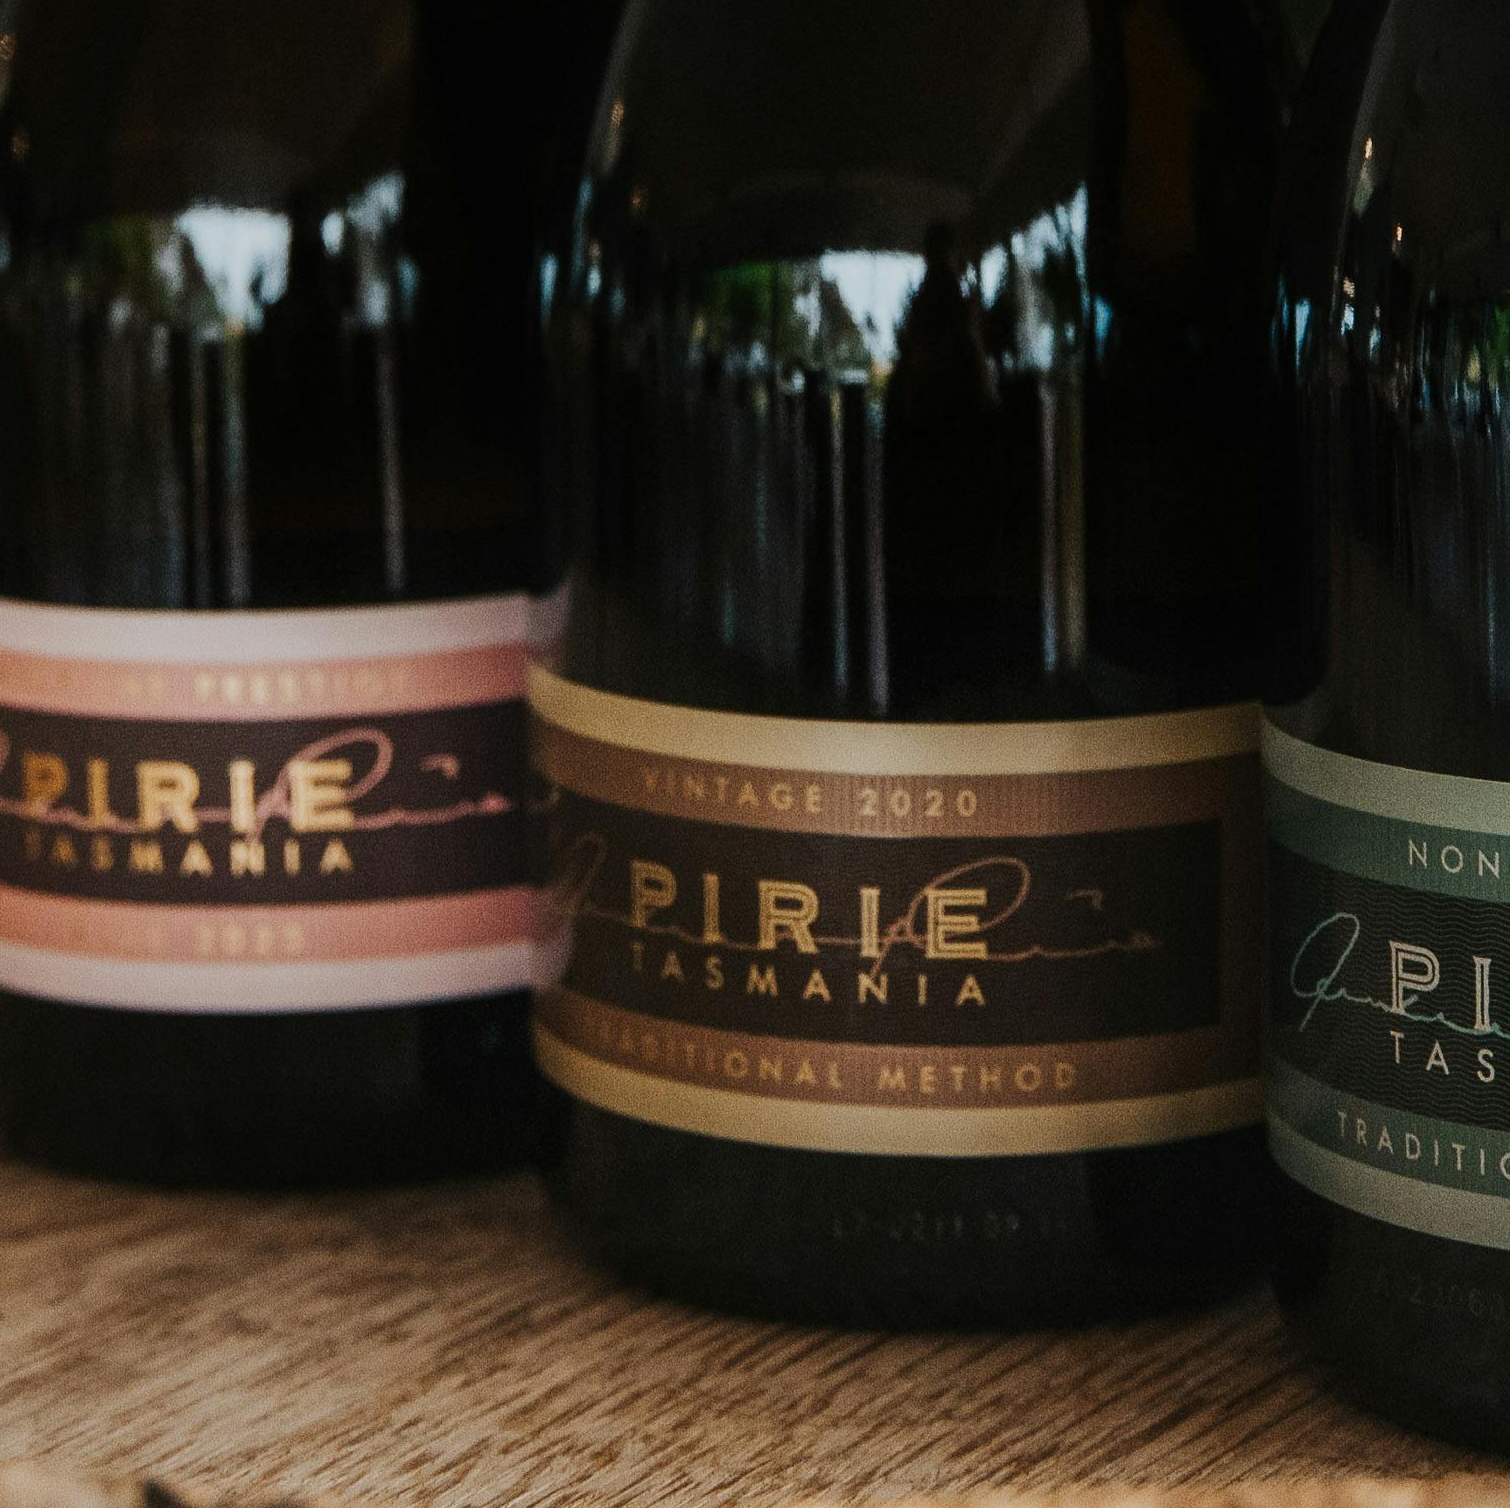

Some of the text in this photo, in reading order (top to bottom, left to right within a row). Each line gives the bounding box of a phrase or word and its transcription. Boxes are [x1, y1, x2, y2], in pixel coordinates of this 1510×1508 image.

[22, 751, 356, 833] PIRIE
[644, 765, 978, 819] VINTAGE 2020
[25, 833, 356, 877] TASMANIA
[1407, 839, 1500, 879] NON
[629, 859, 989, 961] PIRIE
[631, 941, 987, 1007] TASMANIA
[588, 1017, 1077, 1094] ADITIONAL METHOD
